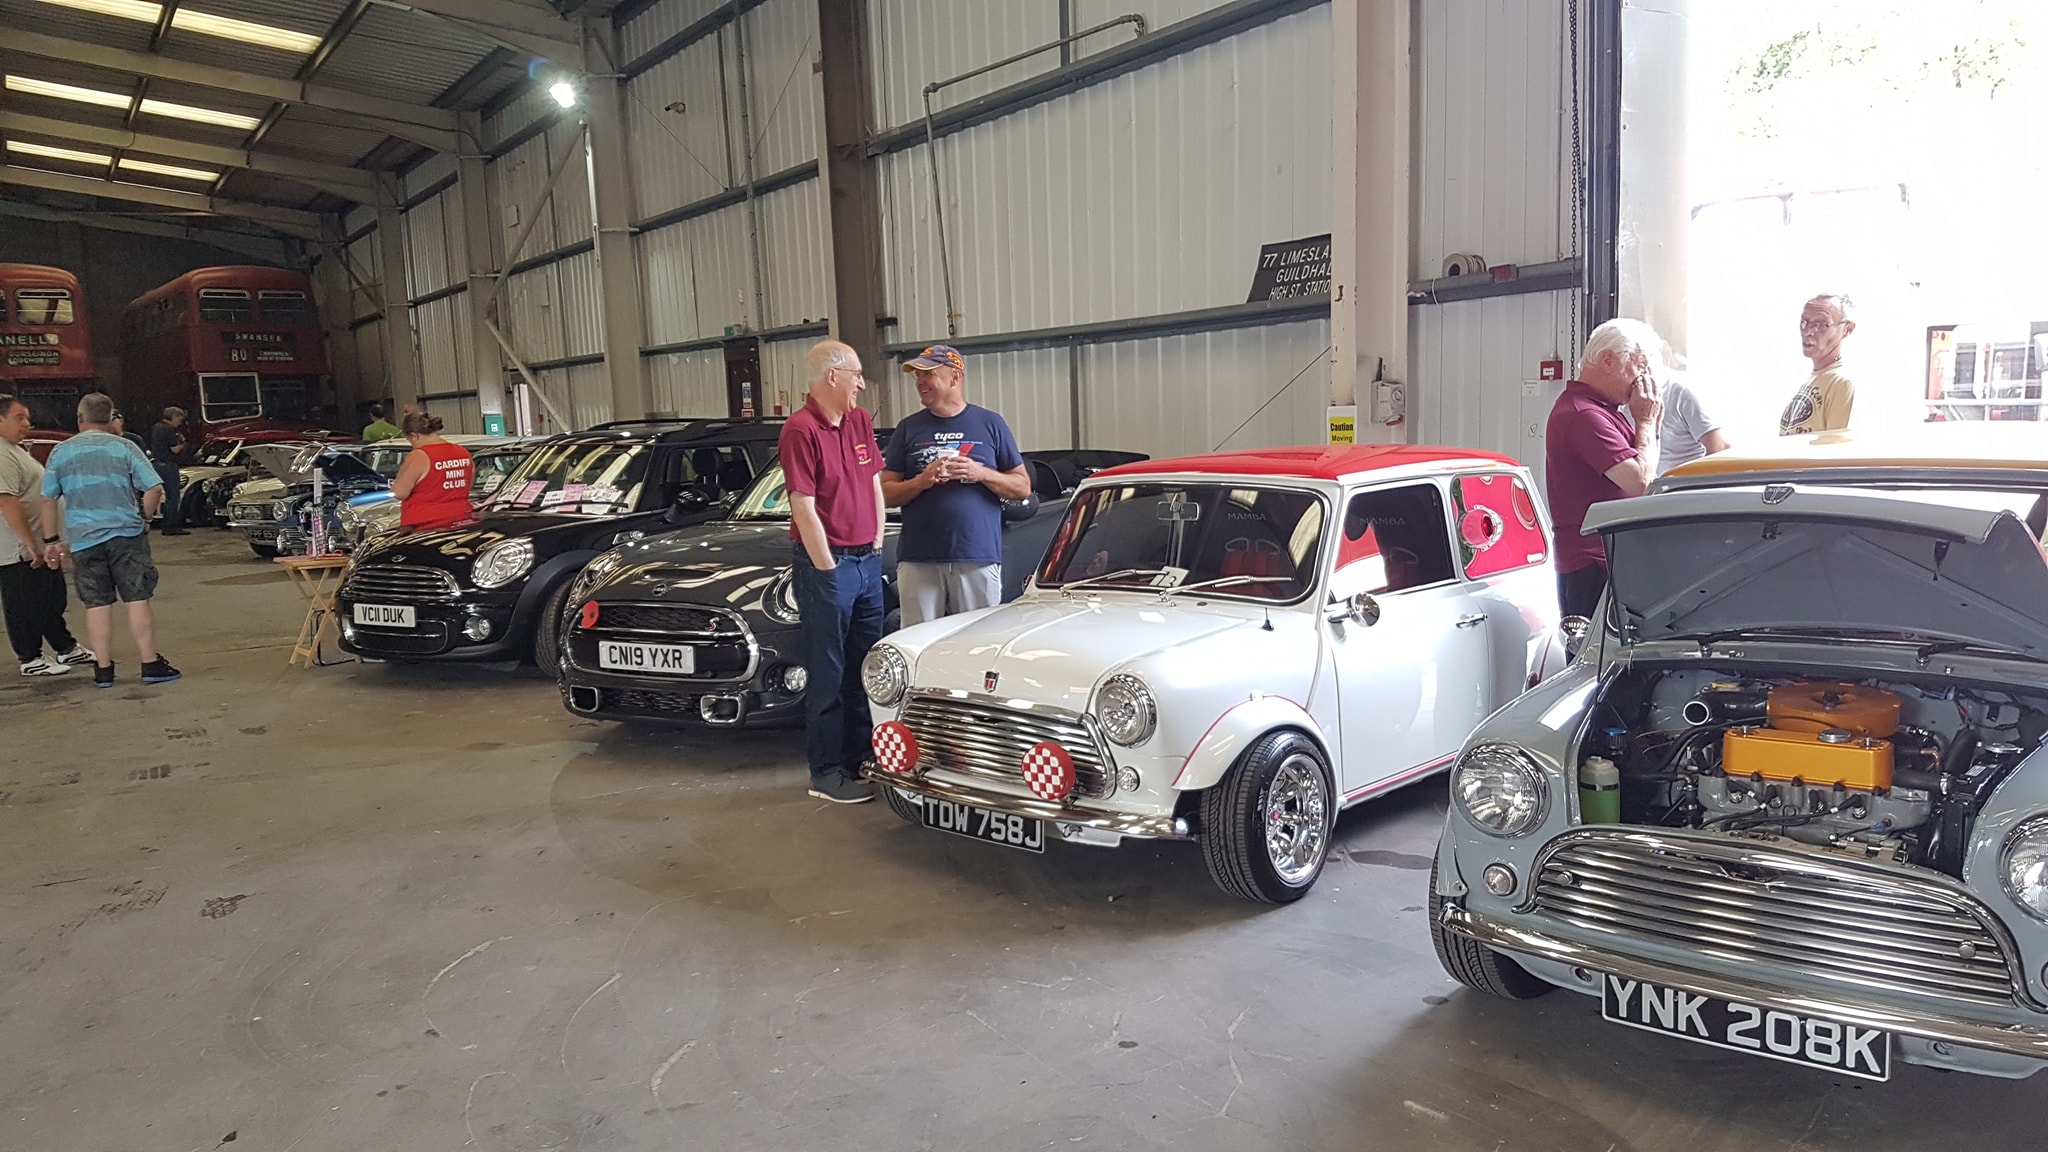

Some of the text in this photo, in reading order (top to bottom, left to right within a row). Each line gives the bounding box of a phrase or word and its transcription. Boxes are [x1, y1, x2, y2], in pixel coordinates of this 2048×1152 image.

[1263, 245, 1331, 268] 77 LIMESLA
[1276, 262, 1331, 283] GUILDHAL
[1268, 285, 1289, 301] HIGH
[1303, 279, 1331, 296] STATIO
[231, 349, 247, 361] 80
[1330, 422, 1354, 432] Caution
[934, 432, 964, 442] tyco
[1331, 435, 1353, 443] Moving
[434, 458, 471, 470] CARDIFF
[445, 469, 465, 479] MINI
[443, 479, 466, 490] CLUB
[1227, 512, 1267, 521] MAMBA
[1359, 516, 1406, 527] MAMBA
[382, 607, 405, 624] DUK
[608, 645, 683, 669] CN19 YXR
[924, 797, 1042, 849] TDW 758J
[1608, 975, 1882, 1075] YNK 208K
